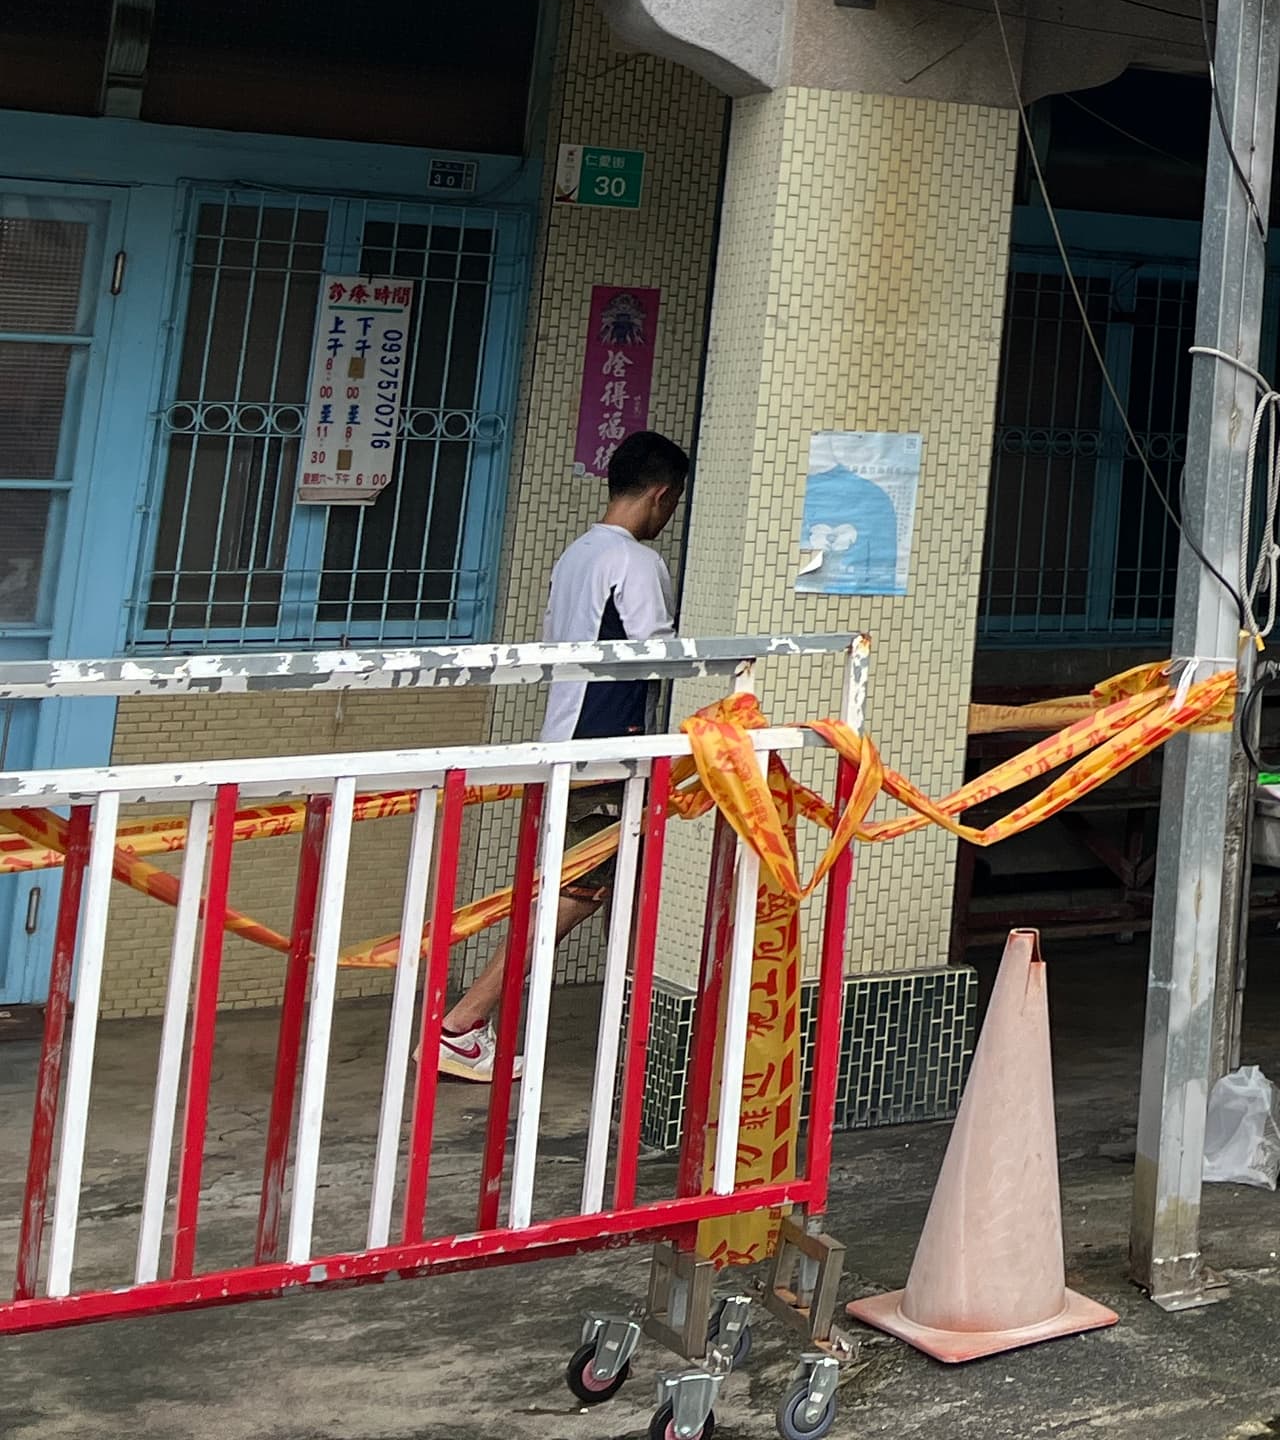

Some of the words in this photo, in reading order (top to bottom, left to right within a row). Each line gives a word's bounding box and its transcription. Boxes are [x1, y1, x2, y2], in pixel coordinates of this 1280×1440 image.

[593, 176, 626, 197] 30
[328, 282, 412, 307] 診療時間
[371, 329, 403, 449] 0937570716
